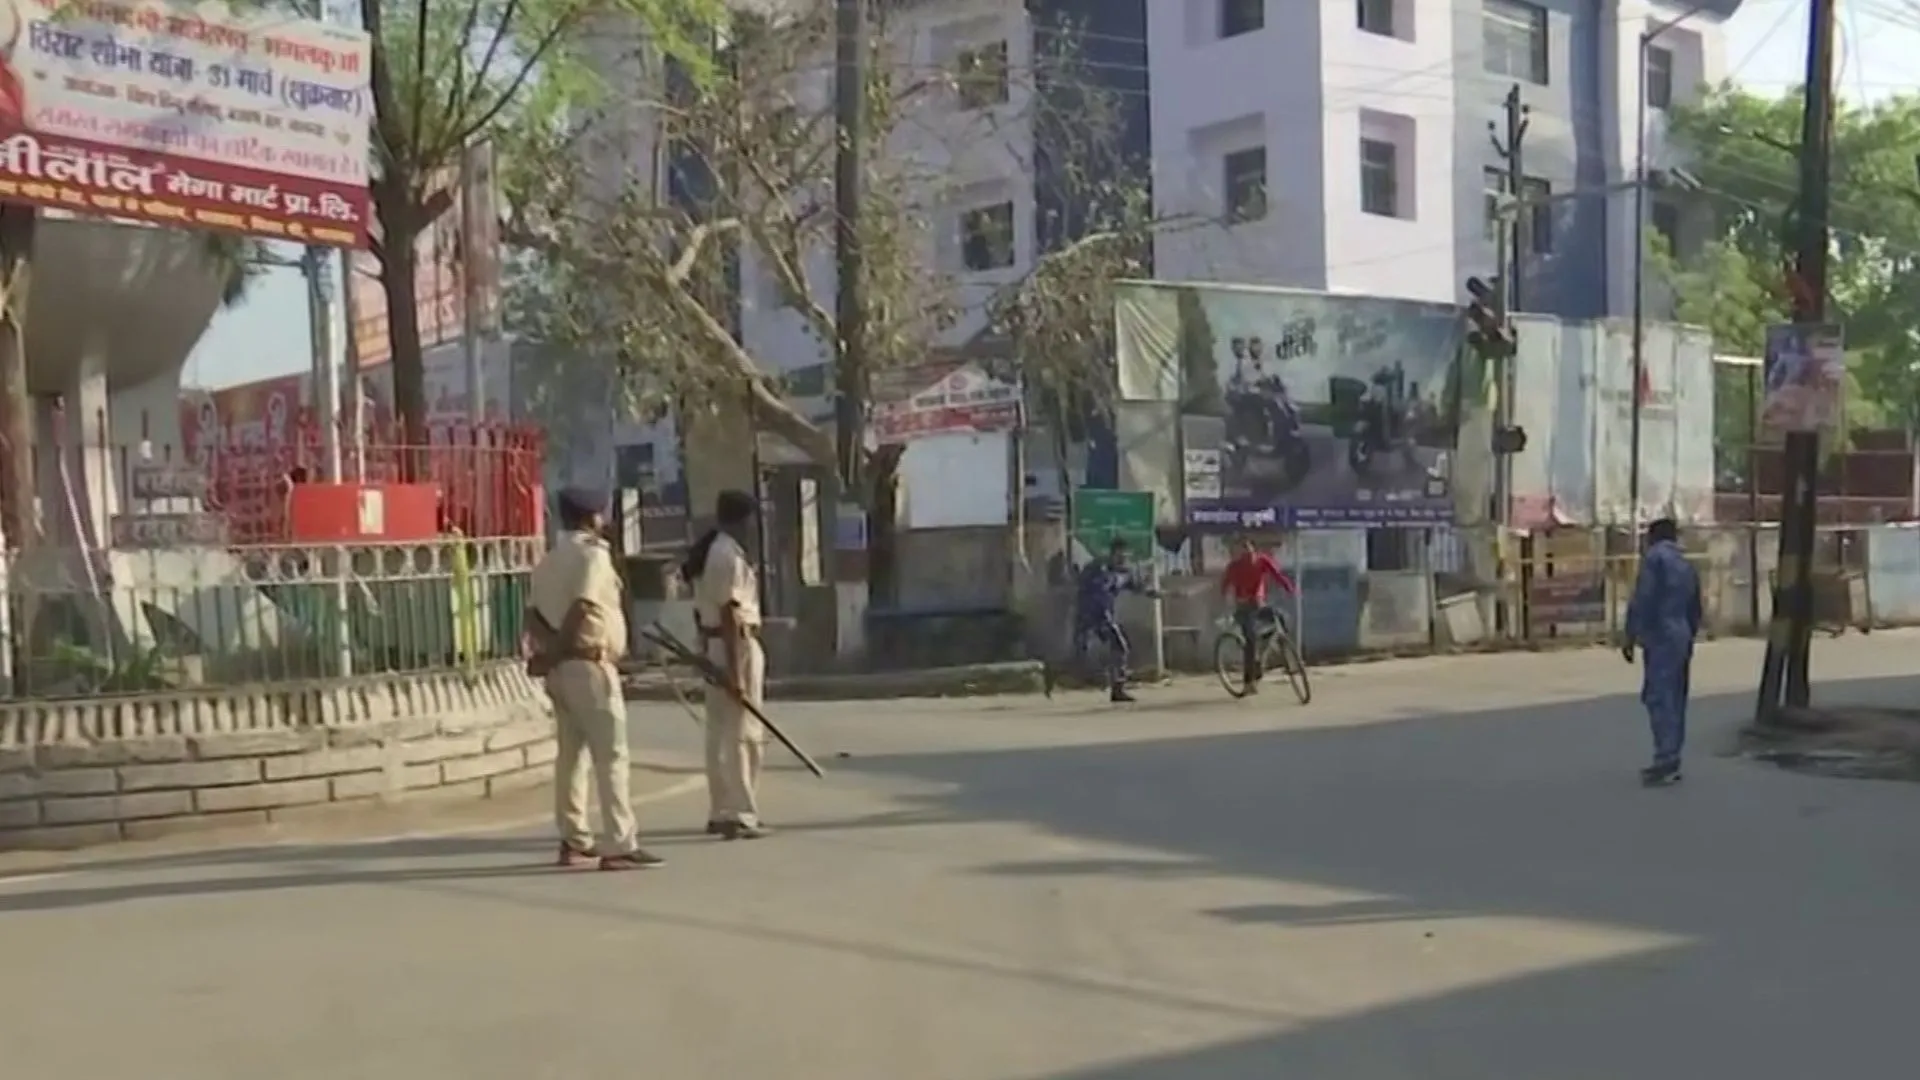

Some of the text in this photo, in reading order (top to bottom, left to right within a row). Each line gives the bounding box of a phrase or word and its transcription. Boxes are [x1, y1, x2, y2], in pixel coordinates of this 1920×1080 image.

[91, 33, 142, 71] शोभा
[208, 63, 231, 88] 31
[236, 67, 273, 97] मार्च
[167, 169, 224, 200] मेगा
[229, 183, 279, 210] मार्ट
